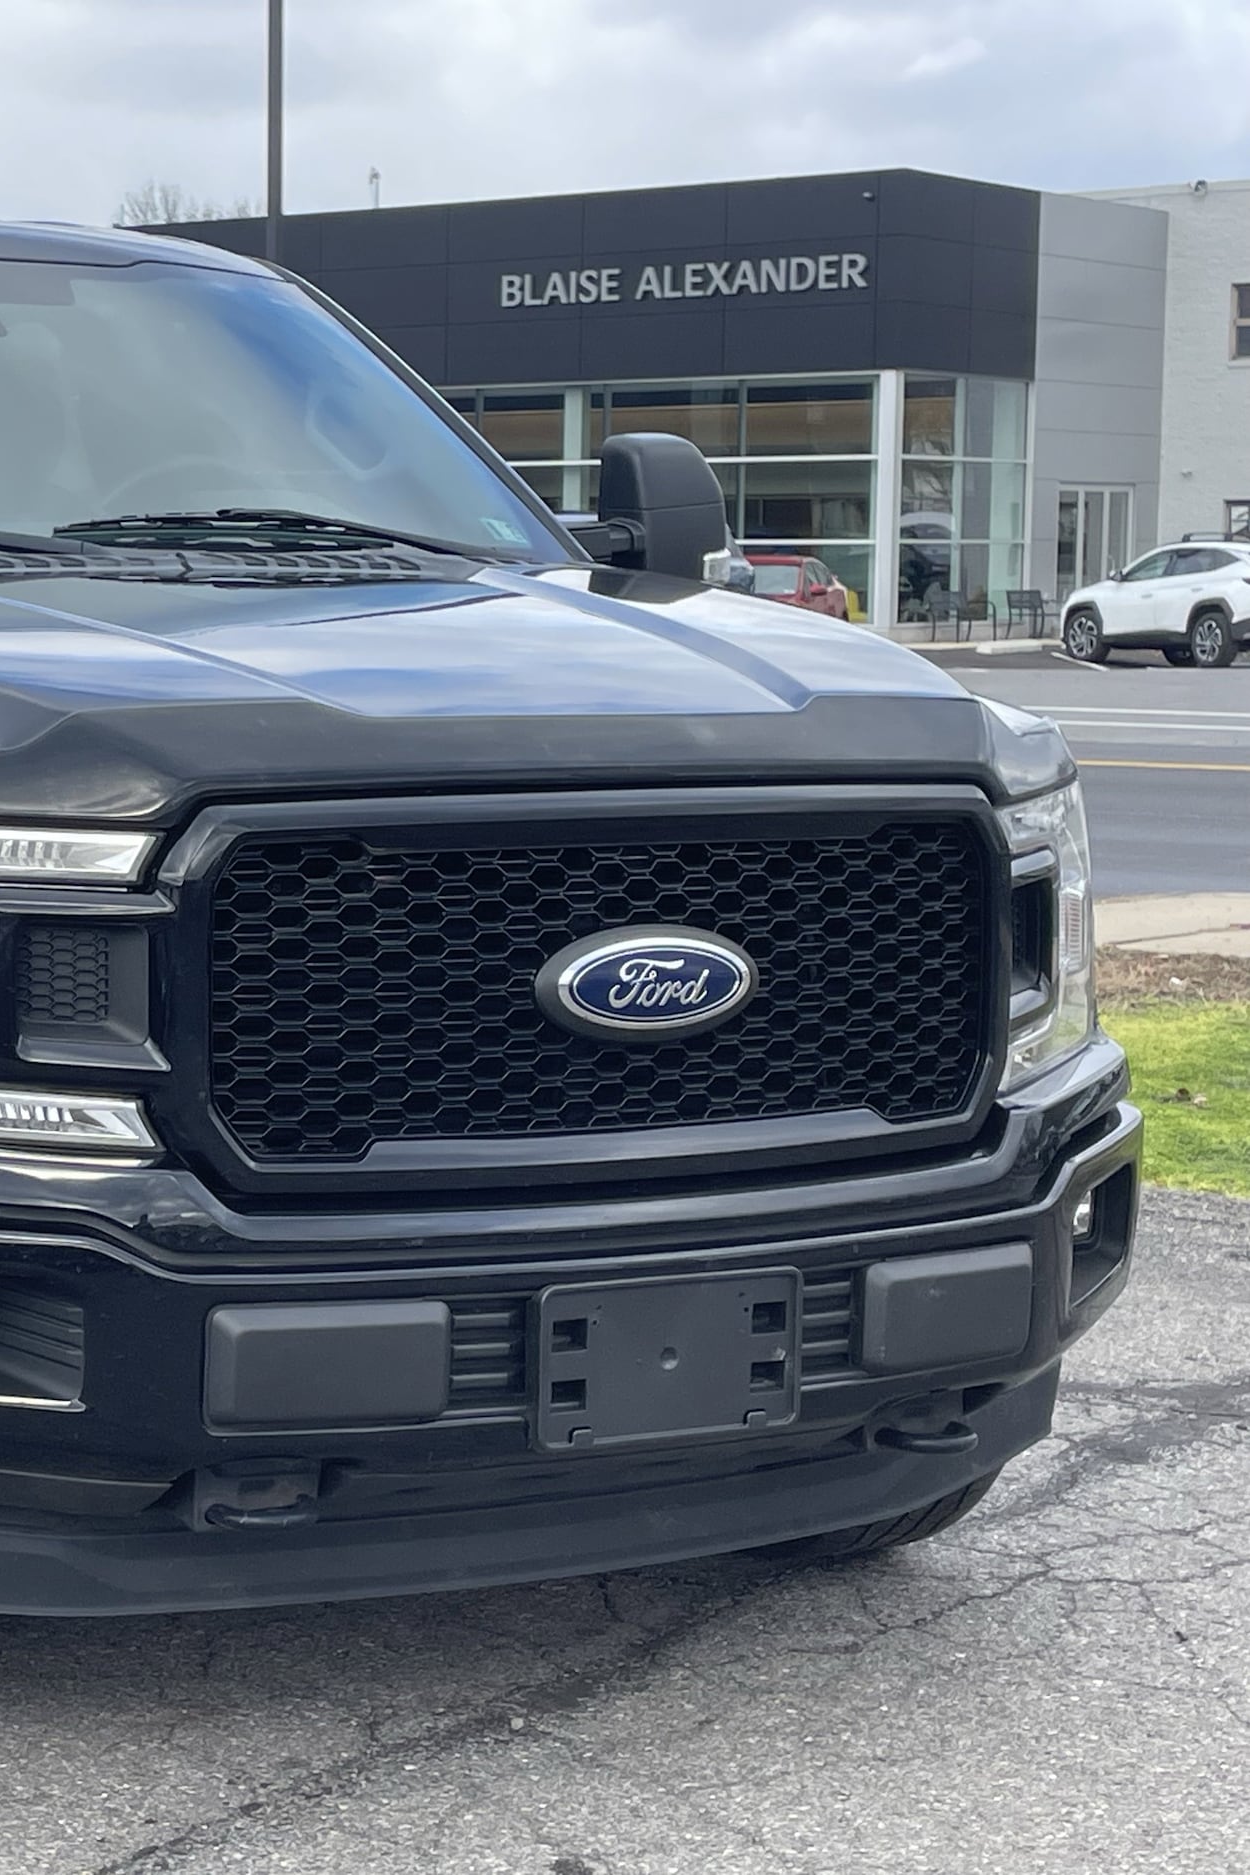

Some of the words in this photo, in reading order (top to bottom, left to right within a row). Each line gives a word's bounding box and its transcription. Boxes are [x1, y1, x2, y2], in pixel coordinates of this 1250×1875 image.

[500, 268, 621, 308] BLAISE
[635, 253, 868, 300] ALEXANDER
[608, 958, 710, 1008] Ford
